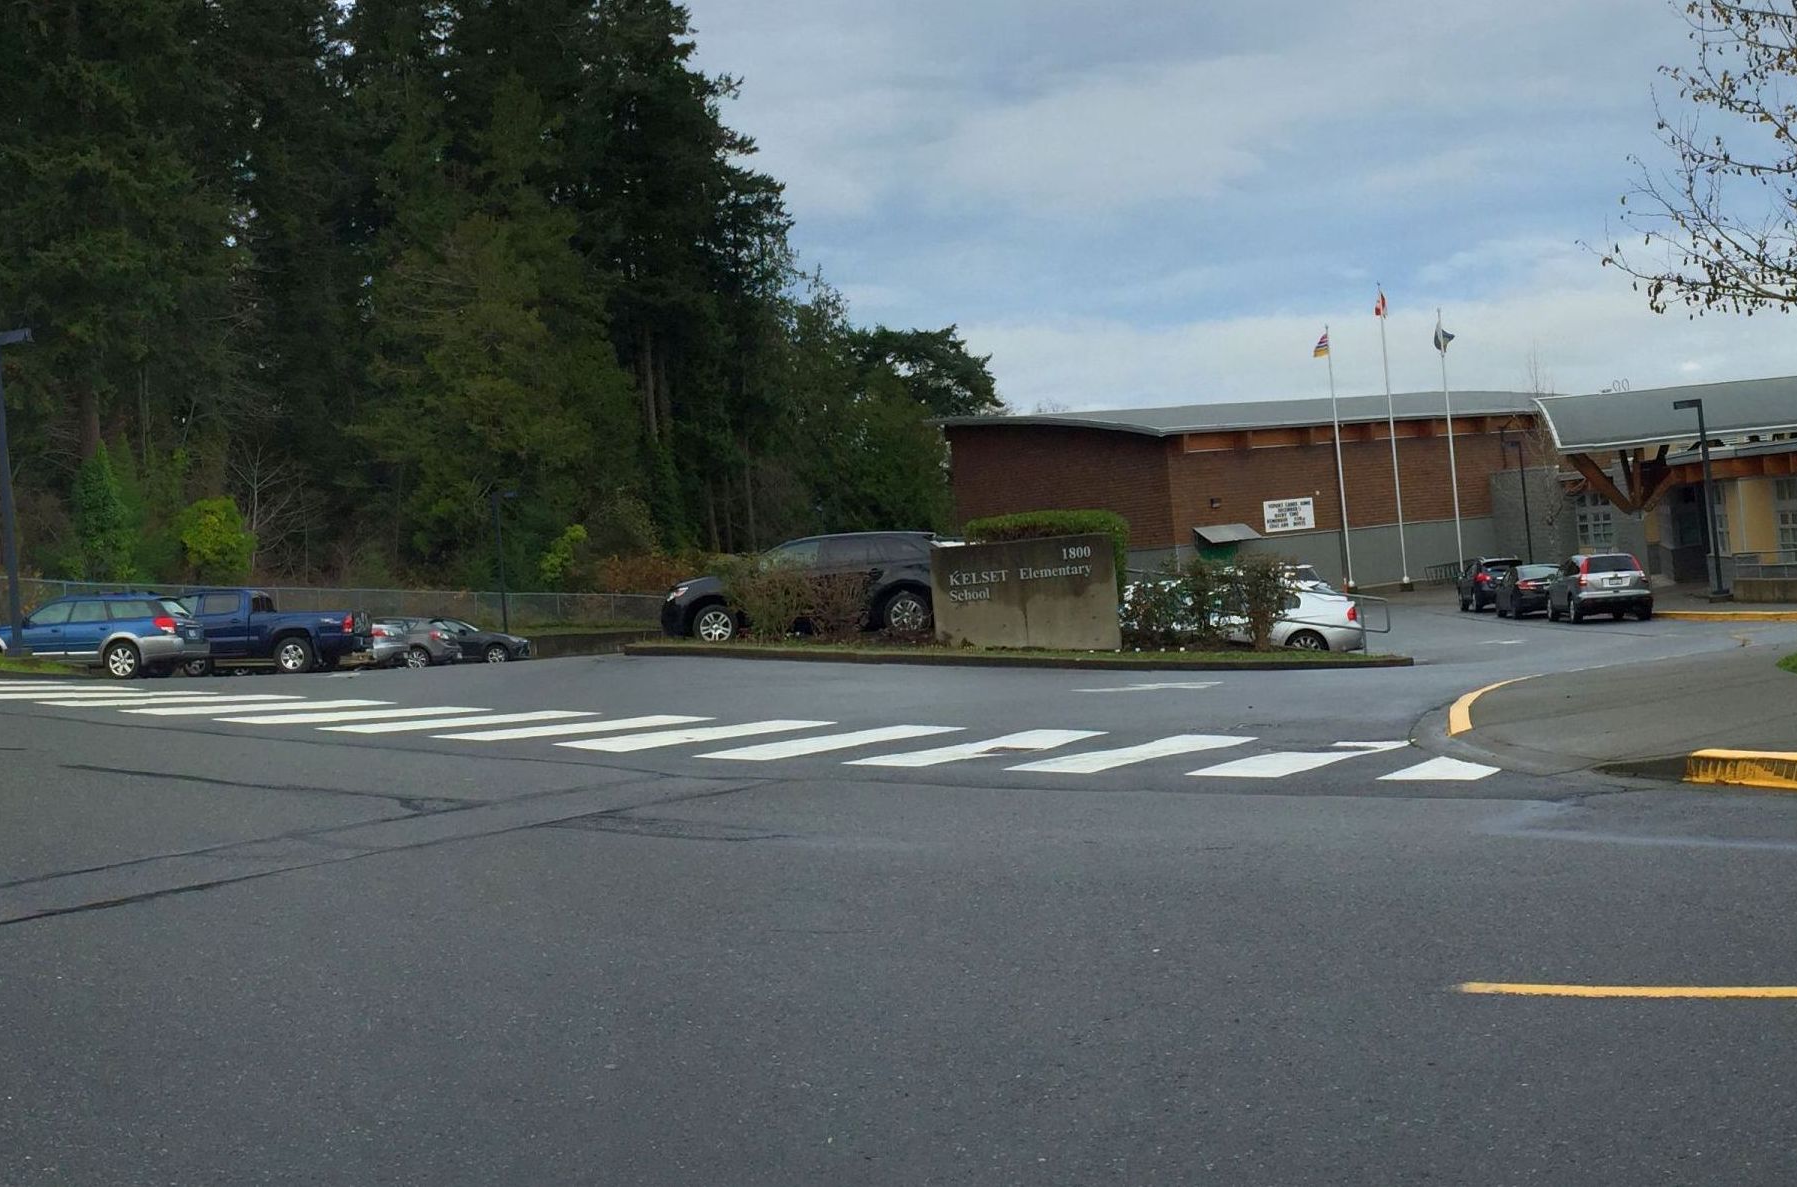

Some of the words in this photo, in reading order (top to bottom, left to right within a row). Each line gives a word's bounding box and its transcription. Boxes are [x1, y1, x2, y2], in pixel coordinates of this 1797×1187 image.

[1062, 545, 1091, 560] 1800
[1019, 563, 1092, 580] Elementary
[949, 588, 990, 602] School
